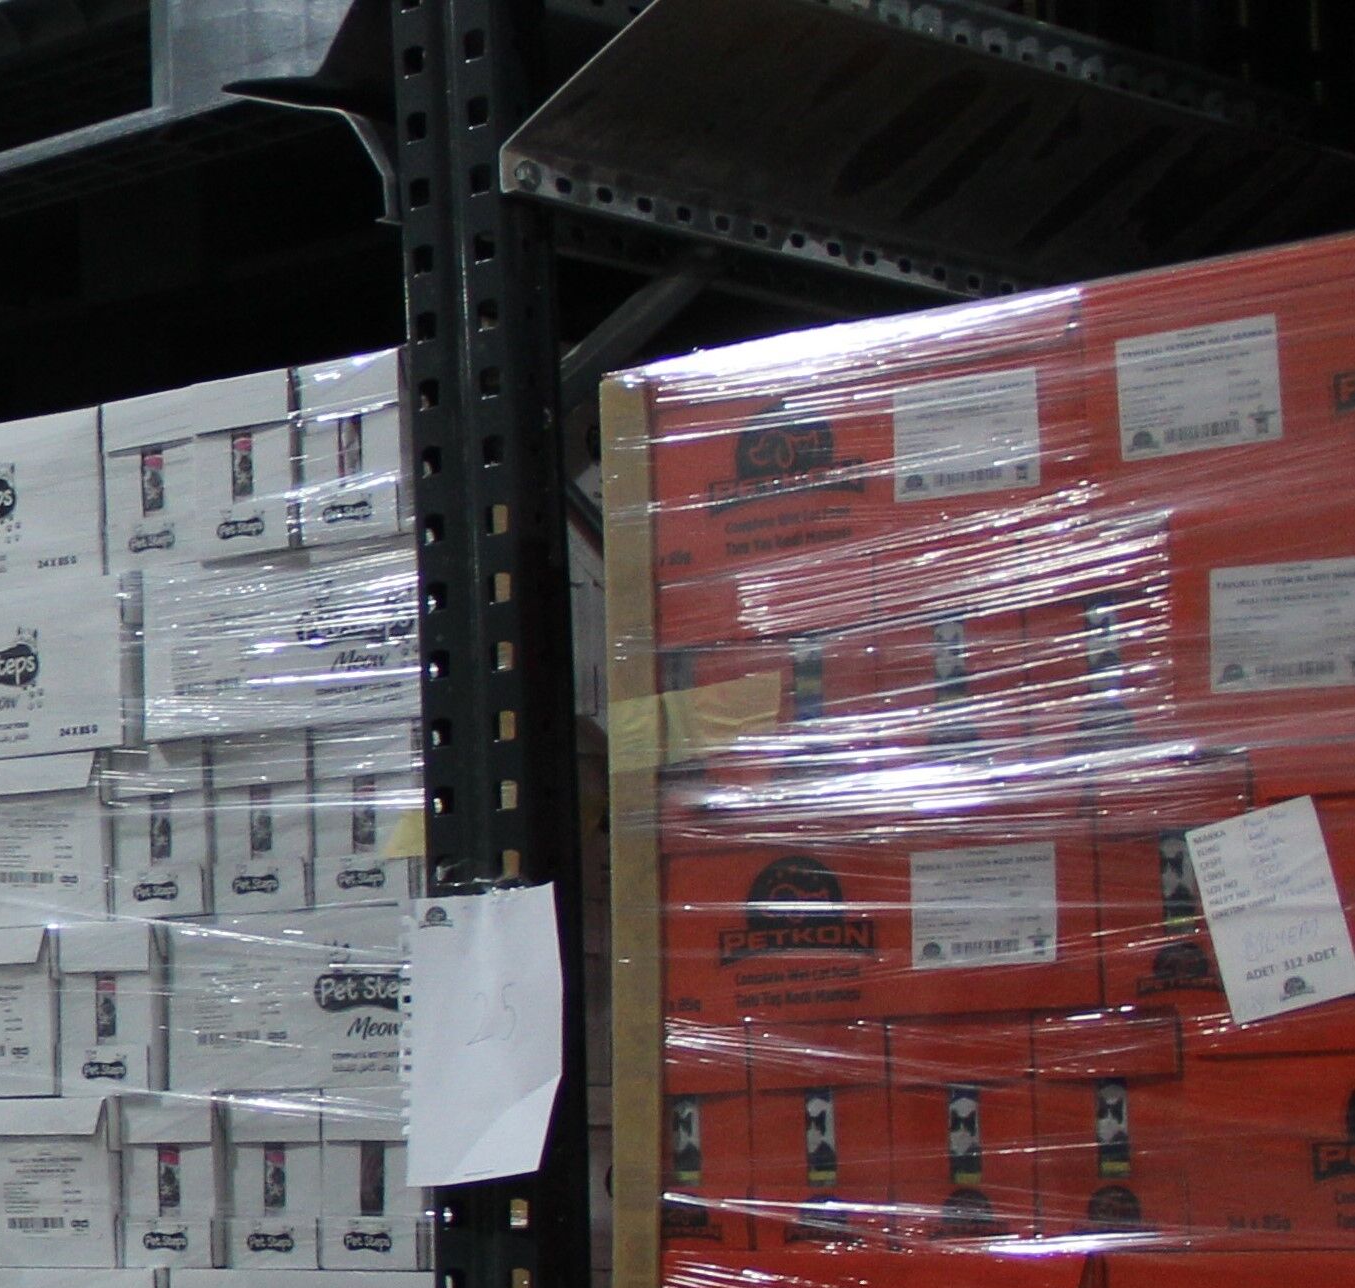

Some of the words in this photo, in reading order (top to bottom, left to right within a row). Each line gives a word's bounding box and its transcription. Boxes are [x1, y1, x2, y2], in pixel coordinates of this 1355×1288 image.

[723, 921, 873, 958] PETKON
[1307, 946, 1338, 964] ADET
[321, 980, 357, 1005] Pet
[364, 976, 399, 998] Ste
